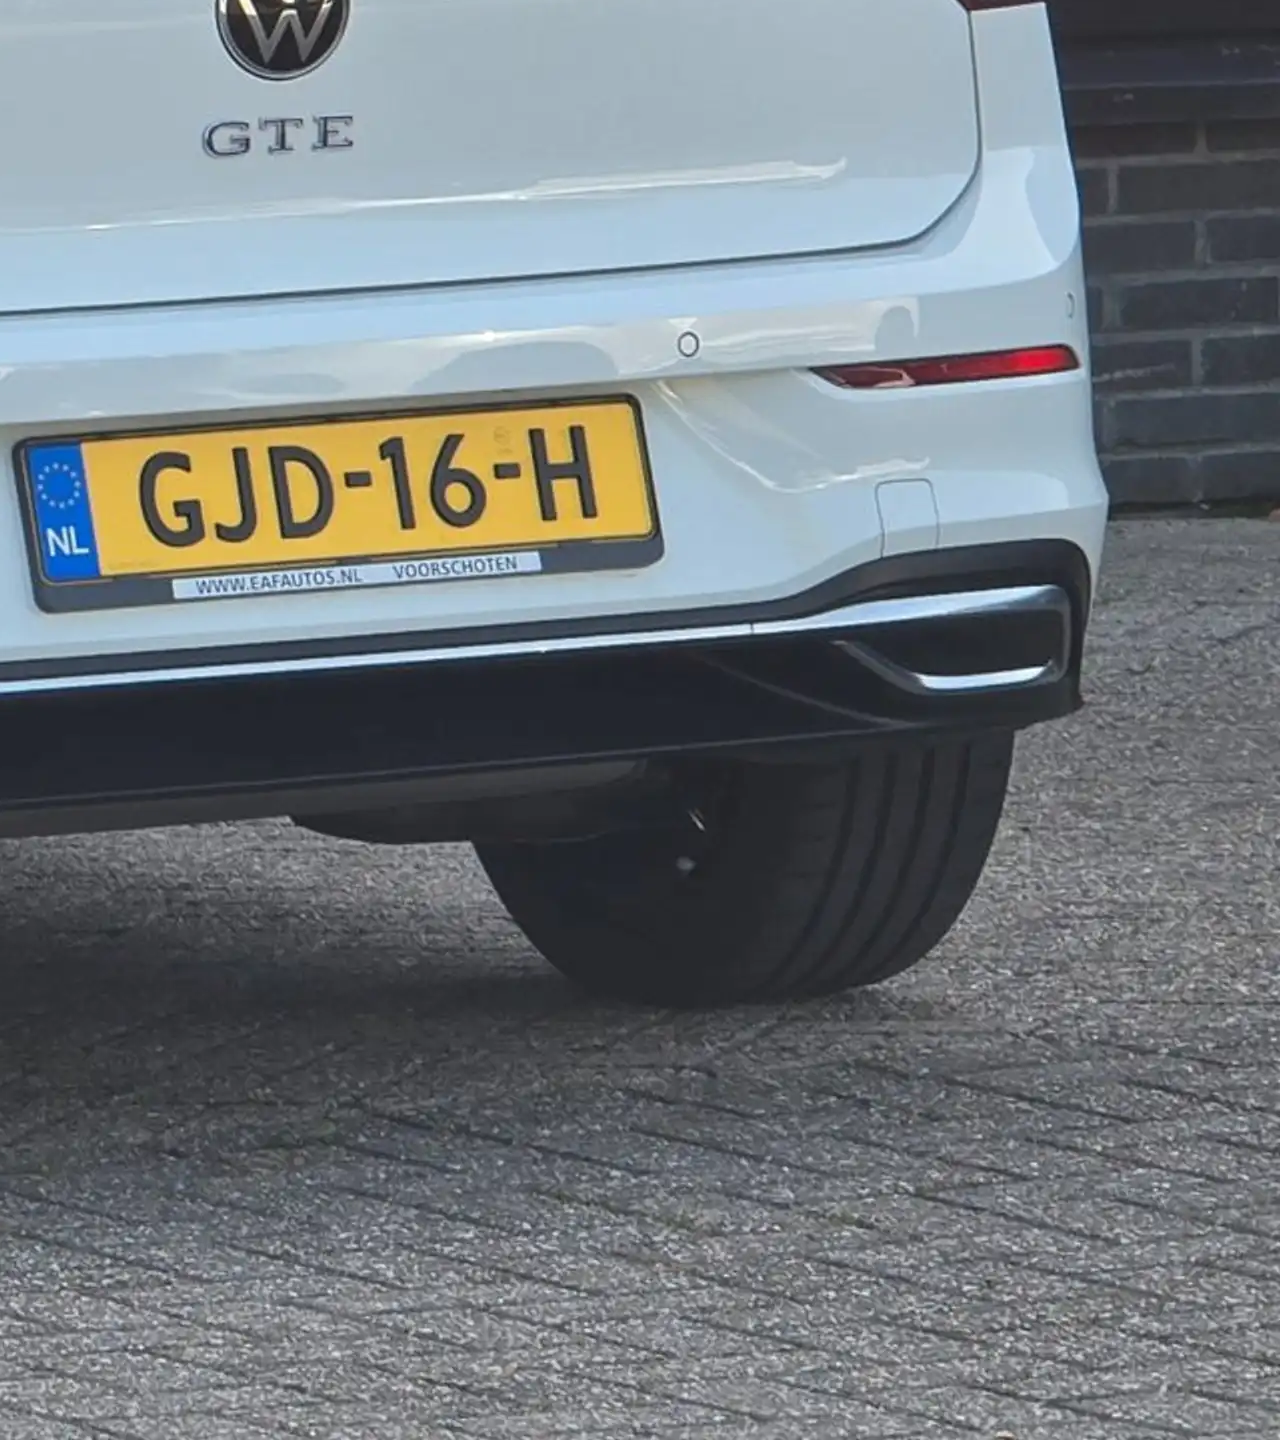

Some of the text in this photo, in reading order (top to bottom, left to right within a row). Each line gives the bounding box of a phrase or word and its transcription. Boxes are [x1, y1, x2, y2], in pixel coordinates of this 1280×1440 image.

[202, 115, 354, 158] GTE
[138, 425, 600, 547] GJD-16-H
[46, 526, 89, 557] NL
[195, 555, 519, 596] WWW.EAFAUTOS.NL VOORSCHOTEN
